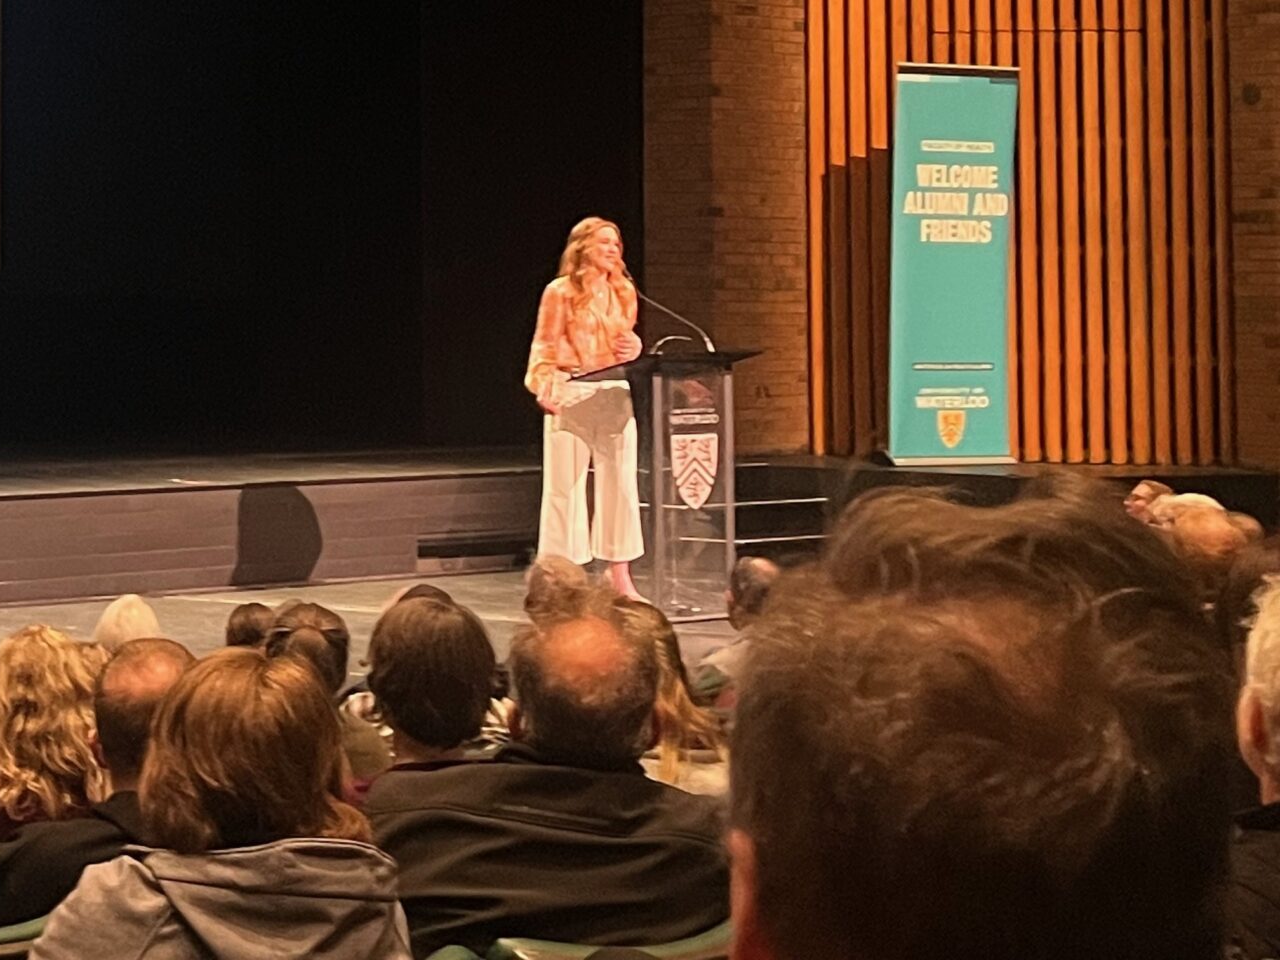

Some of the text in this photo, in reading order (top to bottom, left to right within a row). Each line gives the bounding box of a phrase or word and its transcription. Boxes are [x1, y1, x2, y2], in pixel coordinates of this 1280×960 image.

[916, 164, 999, 188] WELCOME
[903, 191, 1009, 216] ALUMNI AND
[920, 219, 992, 243] FRIENDS
